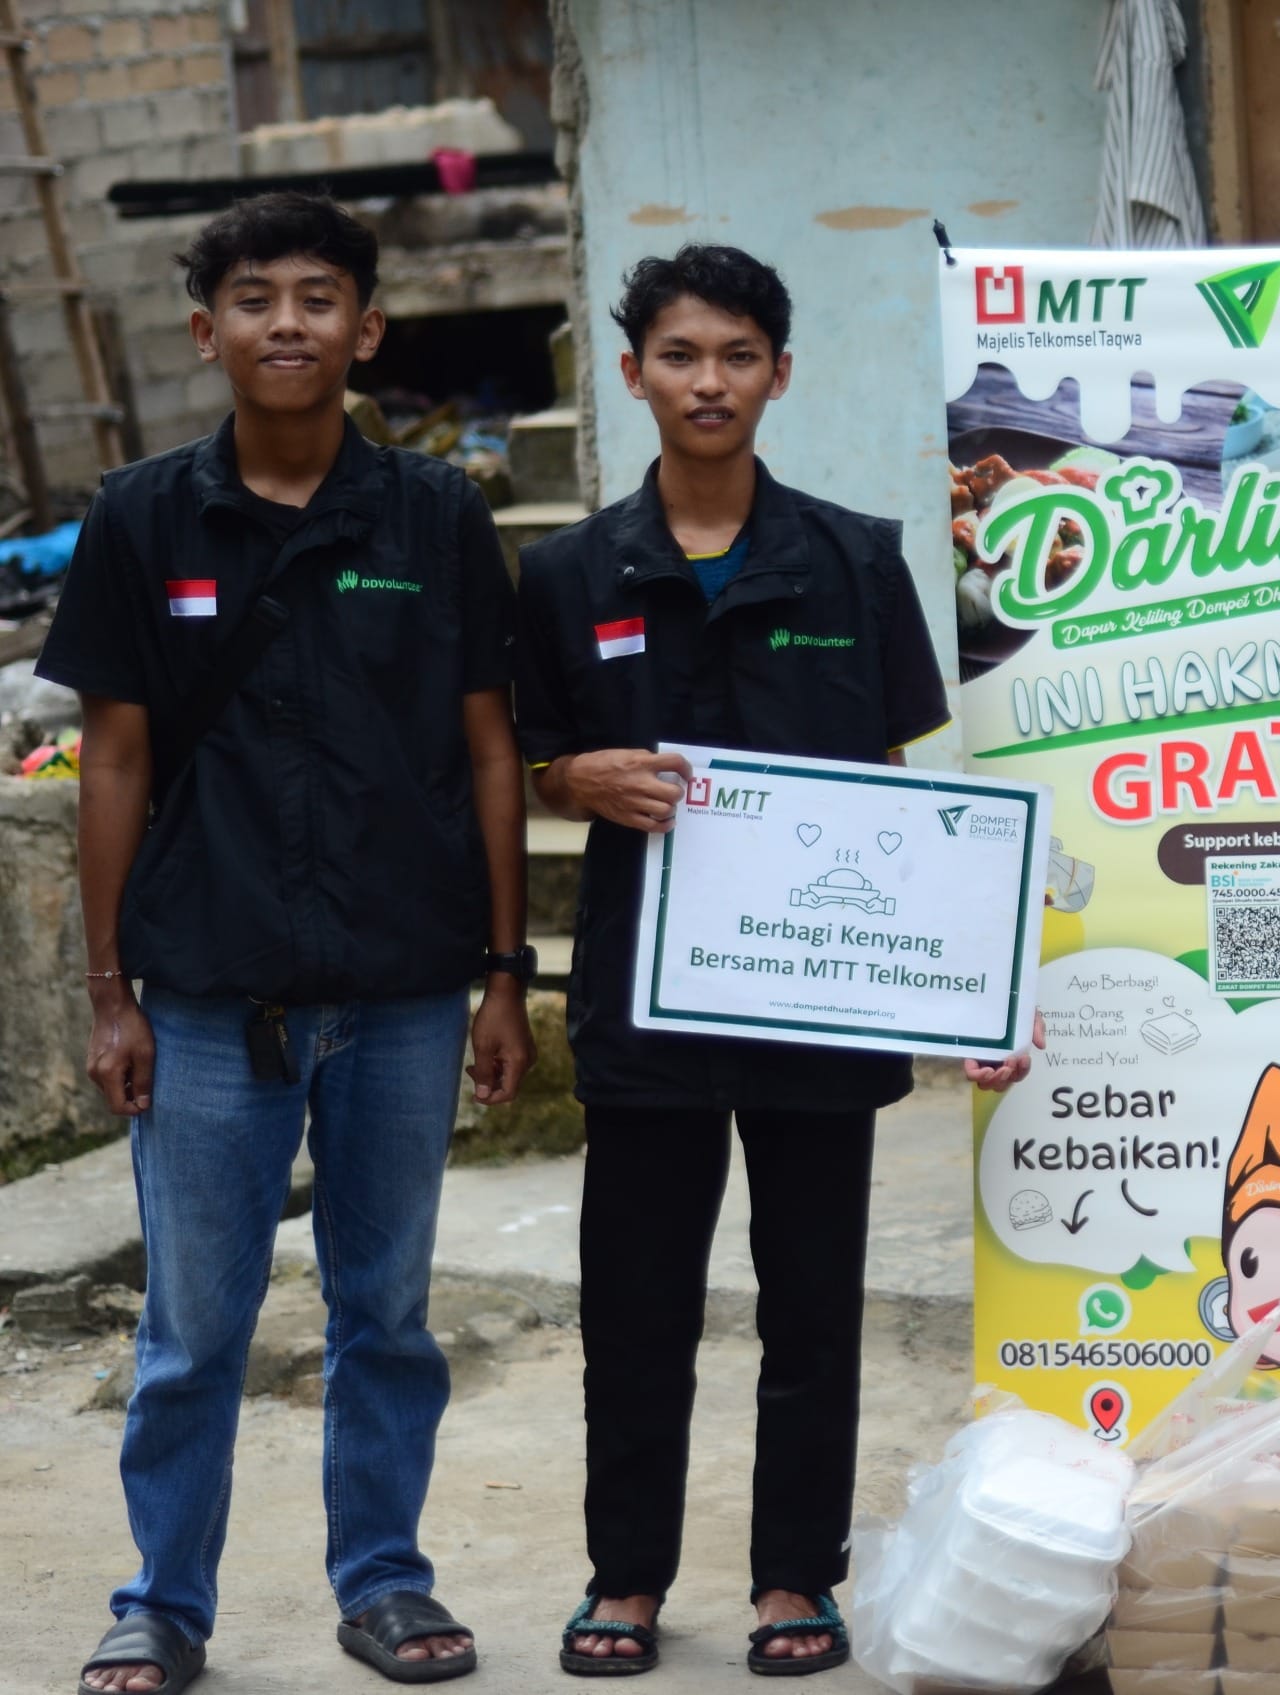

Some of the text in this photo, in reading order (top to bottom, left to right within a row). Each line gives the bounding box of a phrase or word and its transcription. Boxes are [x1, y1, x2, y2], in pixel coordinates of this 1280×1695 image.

[1037, 277, 1148, 324] MTT
[976, 330, 1143, 353] Majelis Telkomsel Taqwa
[1061, 621, 1118, 645] Dapur
[1121, 607, 1183, 632] Keliling
[1186, 592, 1251, 620] Dompet
[793, 634, 856, 648] DDVolunteer
[1011, 665, 1104, 736] INI
[715, 786, 773, 813] MTT
[970, 813, 1019, 828] DOMPET
[969, 824, 1018, 839] DHUAFA
[1183, 832, 1251, 851] Support
[1210, 861, 1258, 871] Rekening
[1210, 873, 1236, 888] BSI
[738, 915, 944, 958] Berbagi Kenyang
[689, 946, 988, 995] Bersama MTT Telkomsel
[1067, 973, 1159, 993] Ayo Berbagi!
[768, 999, 896, 1020] www.dompetdhuafakepri.org
[1078, 1004, 1124, 1023] Orang
[1079, 1022, 1127, 1038] Makan!
[1045, 1051, 1139, 1068] We need You!
[1049, 1083, 1177, 1119] Sebar
[1012, 1134, 1221, 1171] Kebaikan!
[1000, 1340, 1212, 1369] 081546506000
